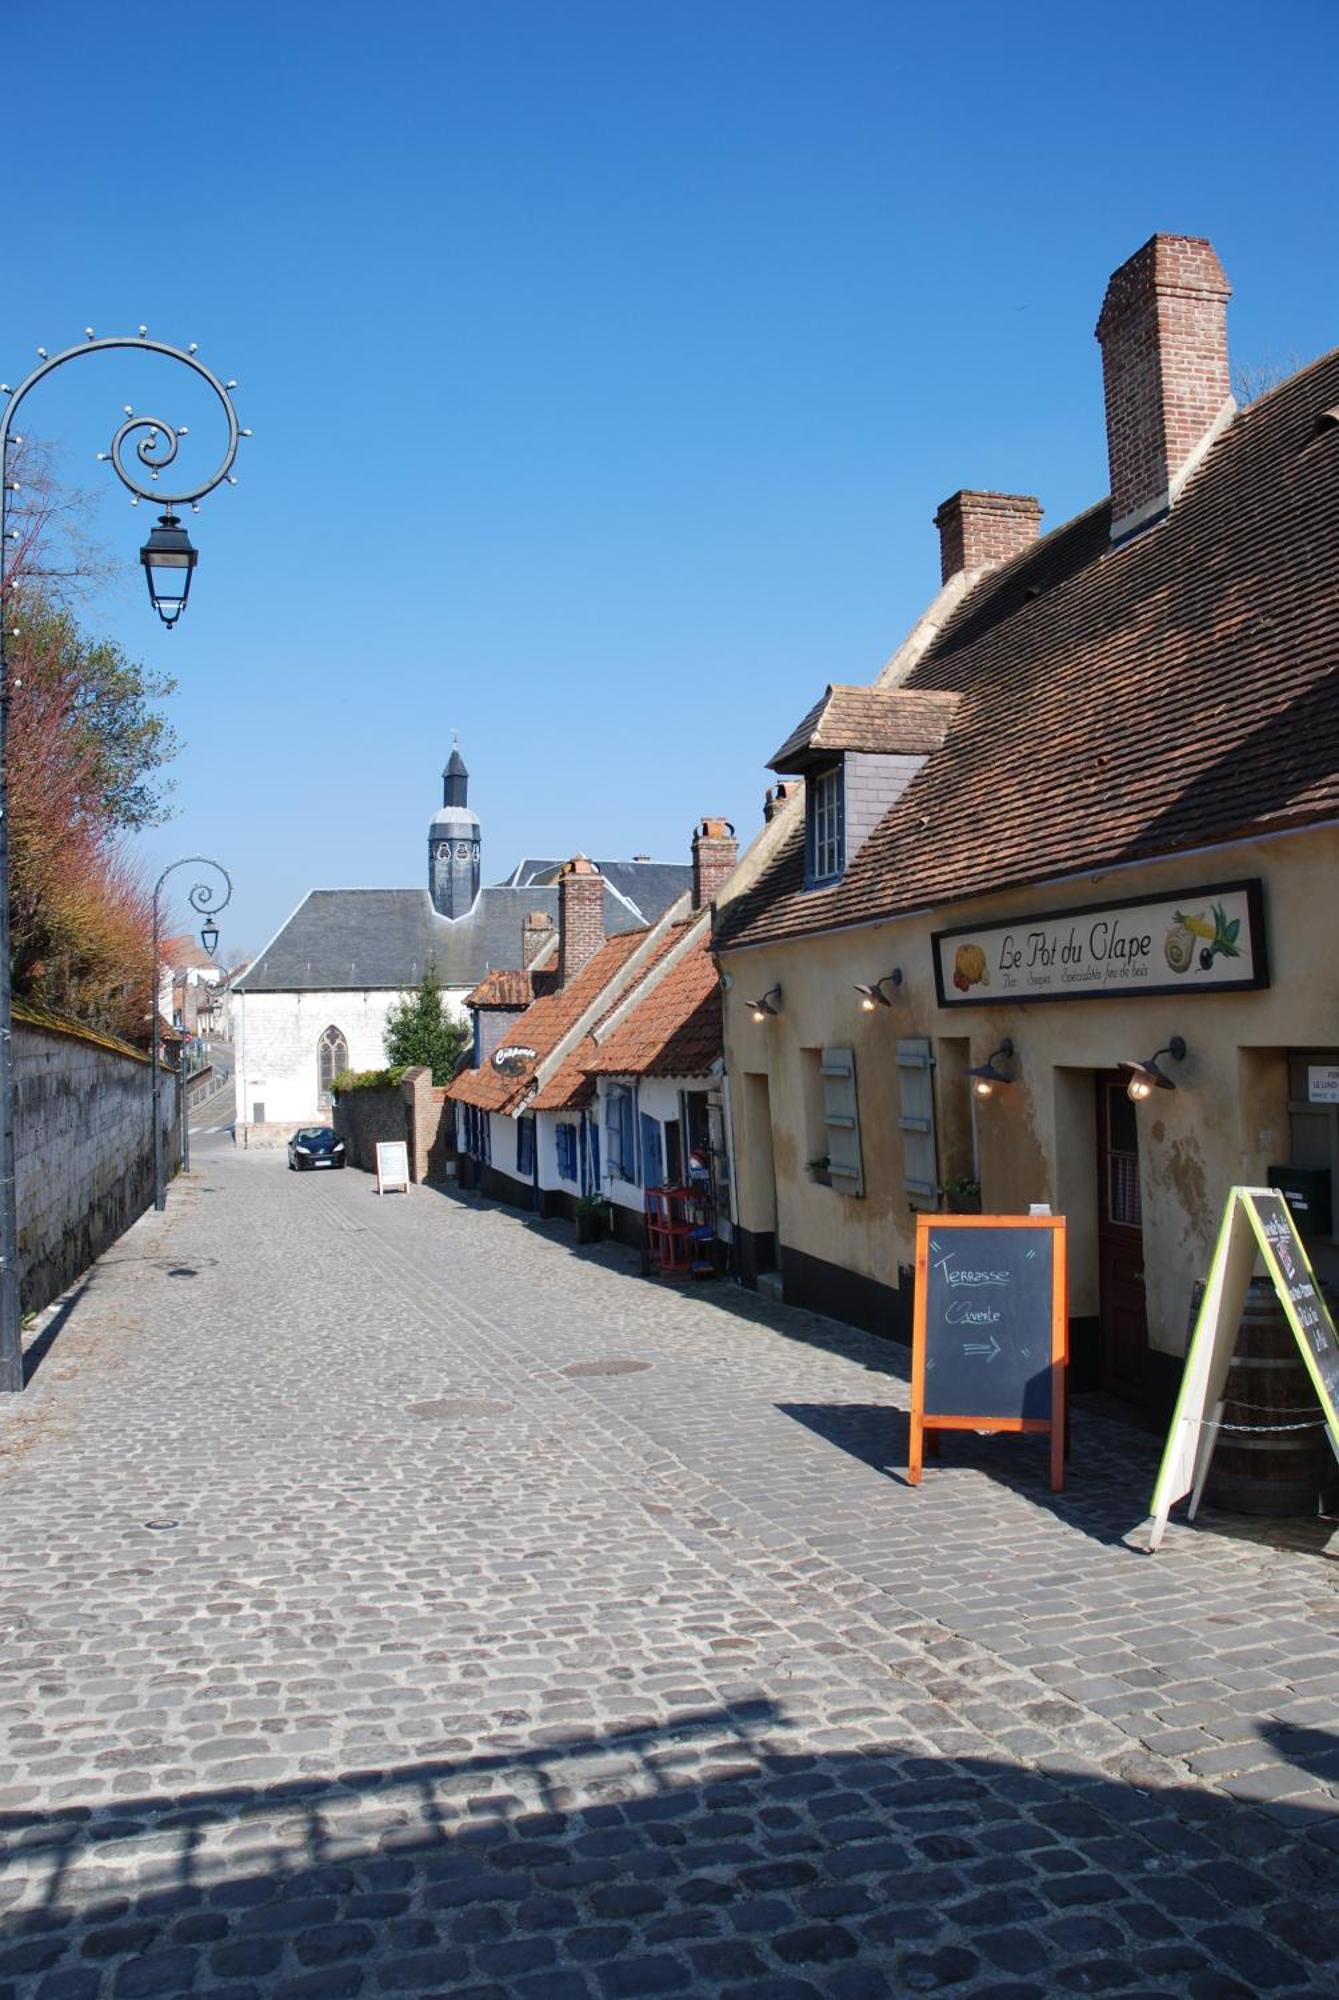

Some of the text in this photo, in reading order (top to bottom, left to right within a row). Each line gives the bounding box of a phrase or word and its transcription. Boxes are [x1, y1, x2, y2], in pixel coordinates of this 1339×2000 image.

[999, 919, 1152, 970] Le Pot du Clape
[945, 1300, 1001, 1324] Ouverte
